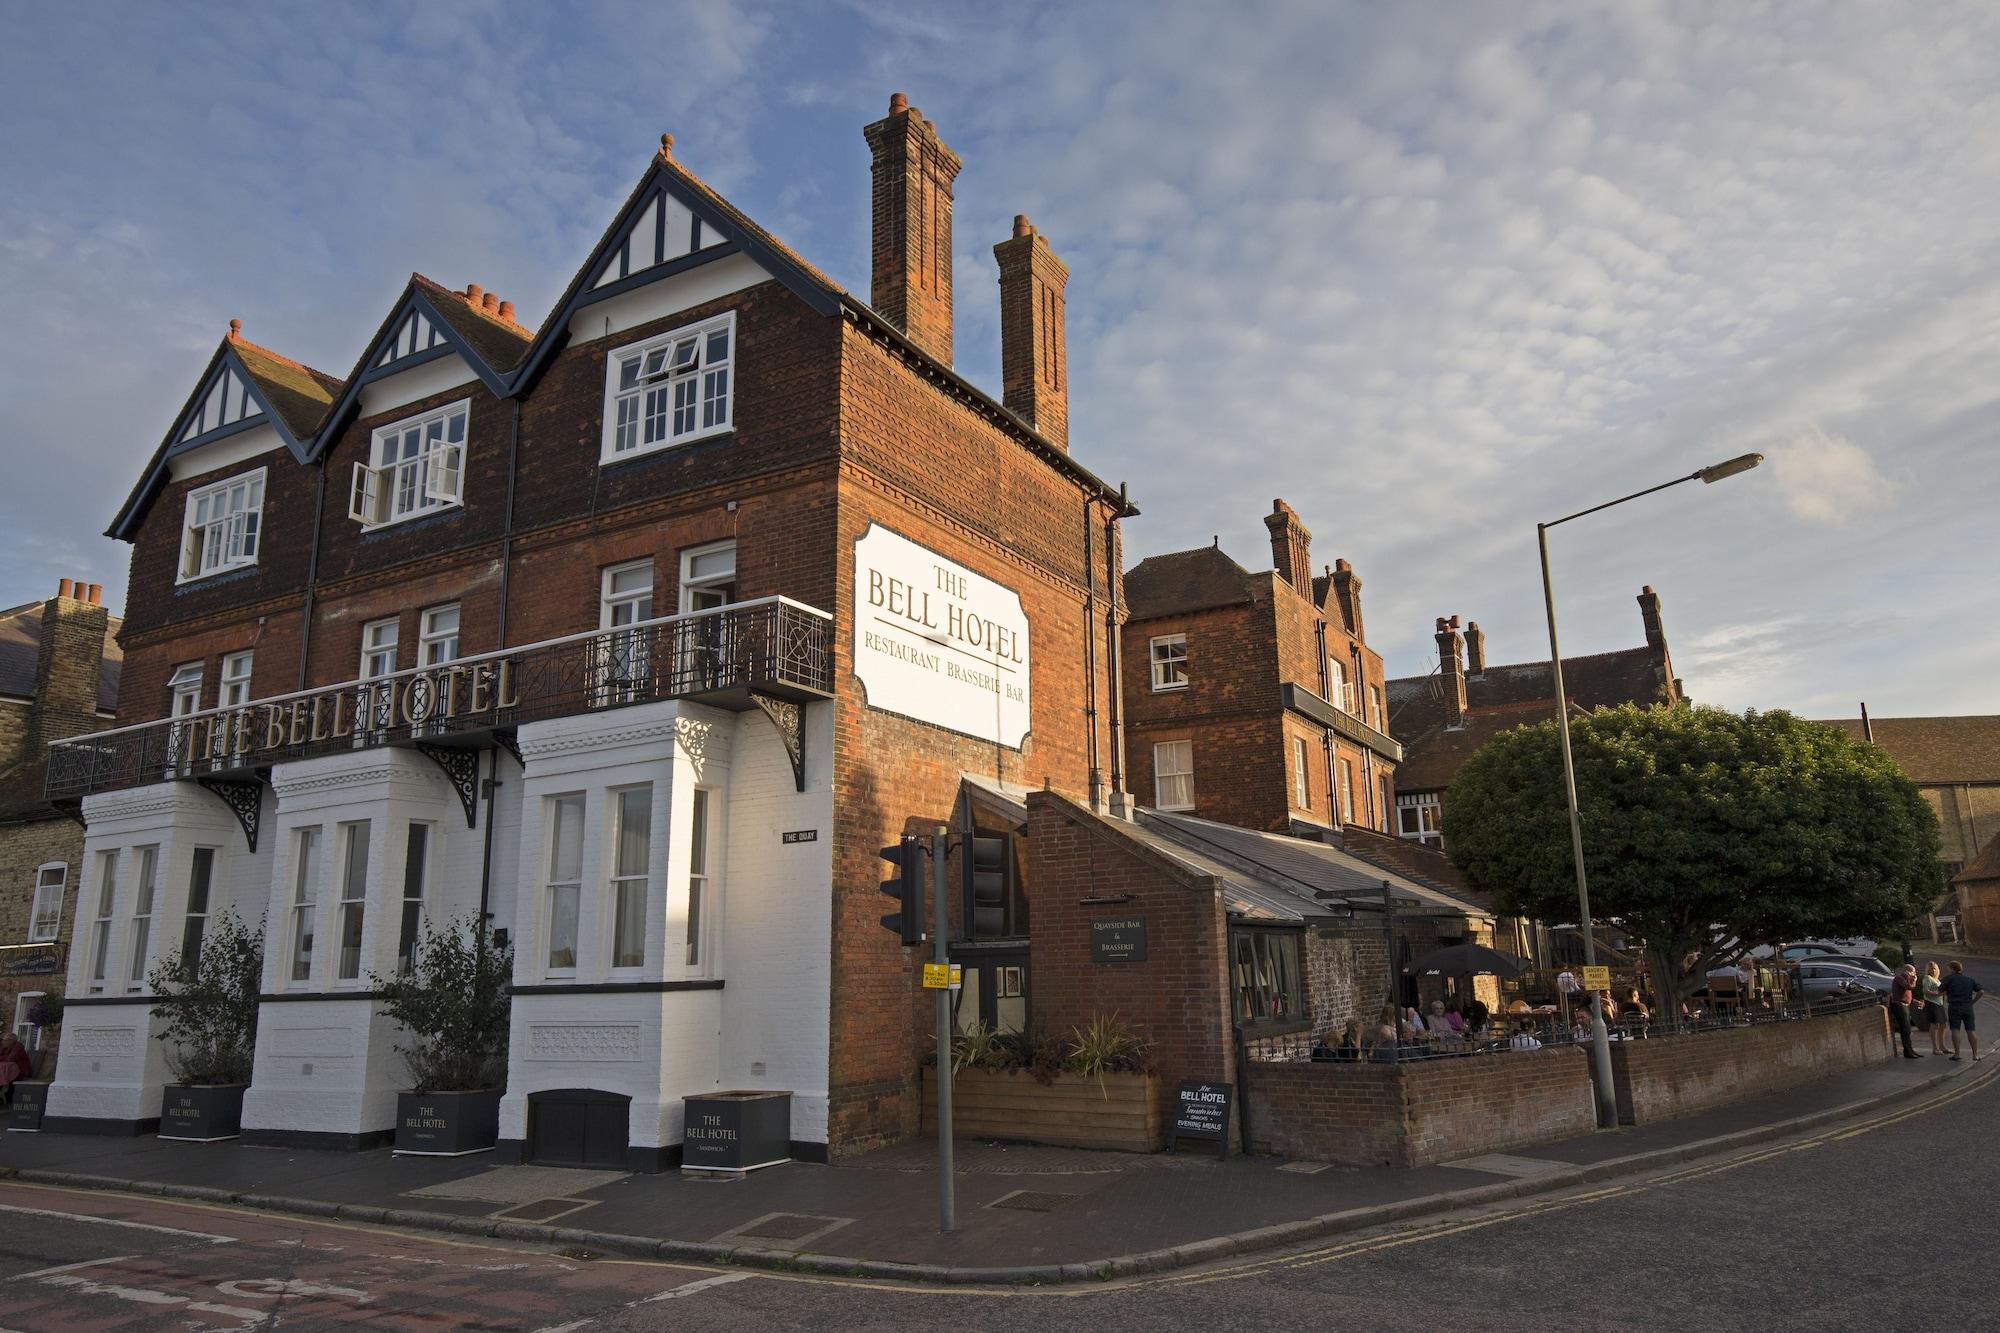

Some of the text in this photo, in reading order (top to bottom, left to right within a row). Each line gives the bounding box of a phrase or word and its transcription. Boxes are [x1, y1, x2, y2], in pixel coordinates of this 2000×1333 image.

[933, 565, 967, 600] THE
[868, 568, 1023, 664] BELL HOTEL
[865, 631, 1024, 703] RESTAURANT BRASSERIE BAR
[182, 659, 520, 761] THE BELL HOTEL
[784, 831, 815, 842] THE QUAY
[1093, 921, 1140, 930] QUAYSIDE BAR
[1114, 932, 1120, 940] &
[1101, 943, 1134, 951] BRASSERIE
[180, 1098, 192, 1107] THE
[1181, 1091, 1226, 1103] BELL HOTEL
[169, 1108, 200, 1118] BELL HOTEL
[420, 1106, 434, 1116] THE
[406, 1118, 446, 1129] BELL HOTEL
[703, 1115, 721, 1126] THE
[1177, 1120, 1222, 1130] EVENING MEALS
[687, 1127, 738, 1140] BELL HOTEL
